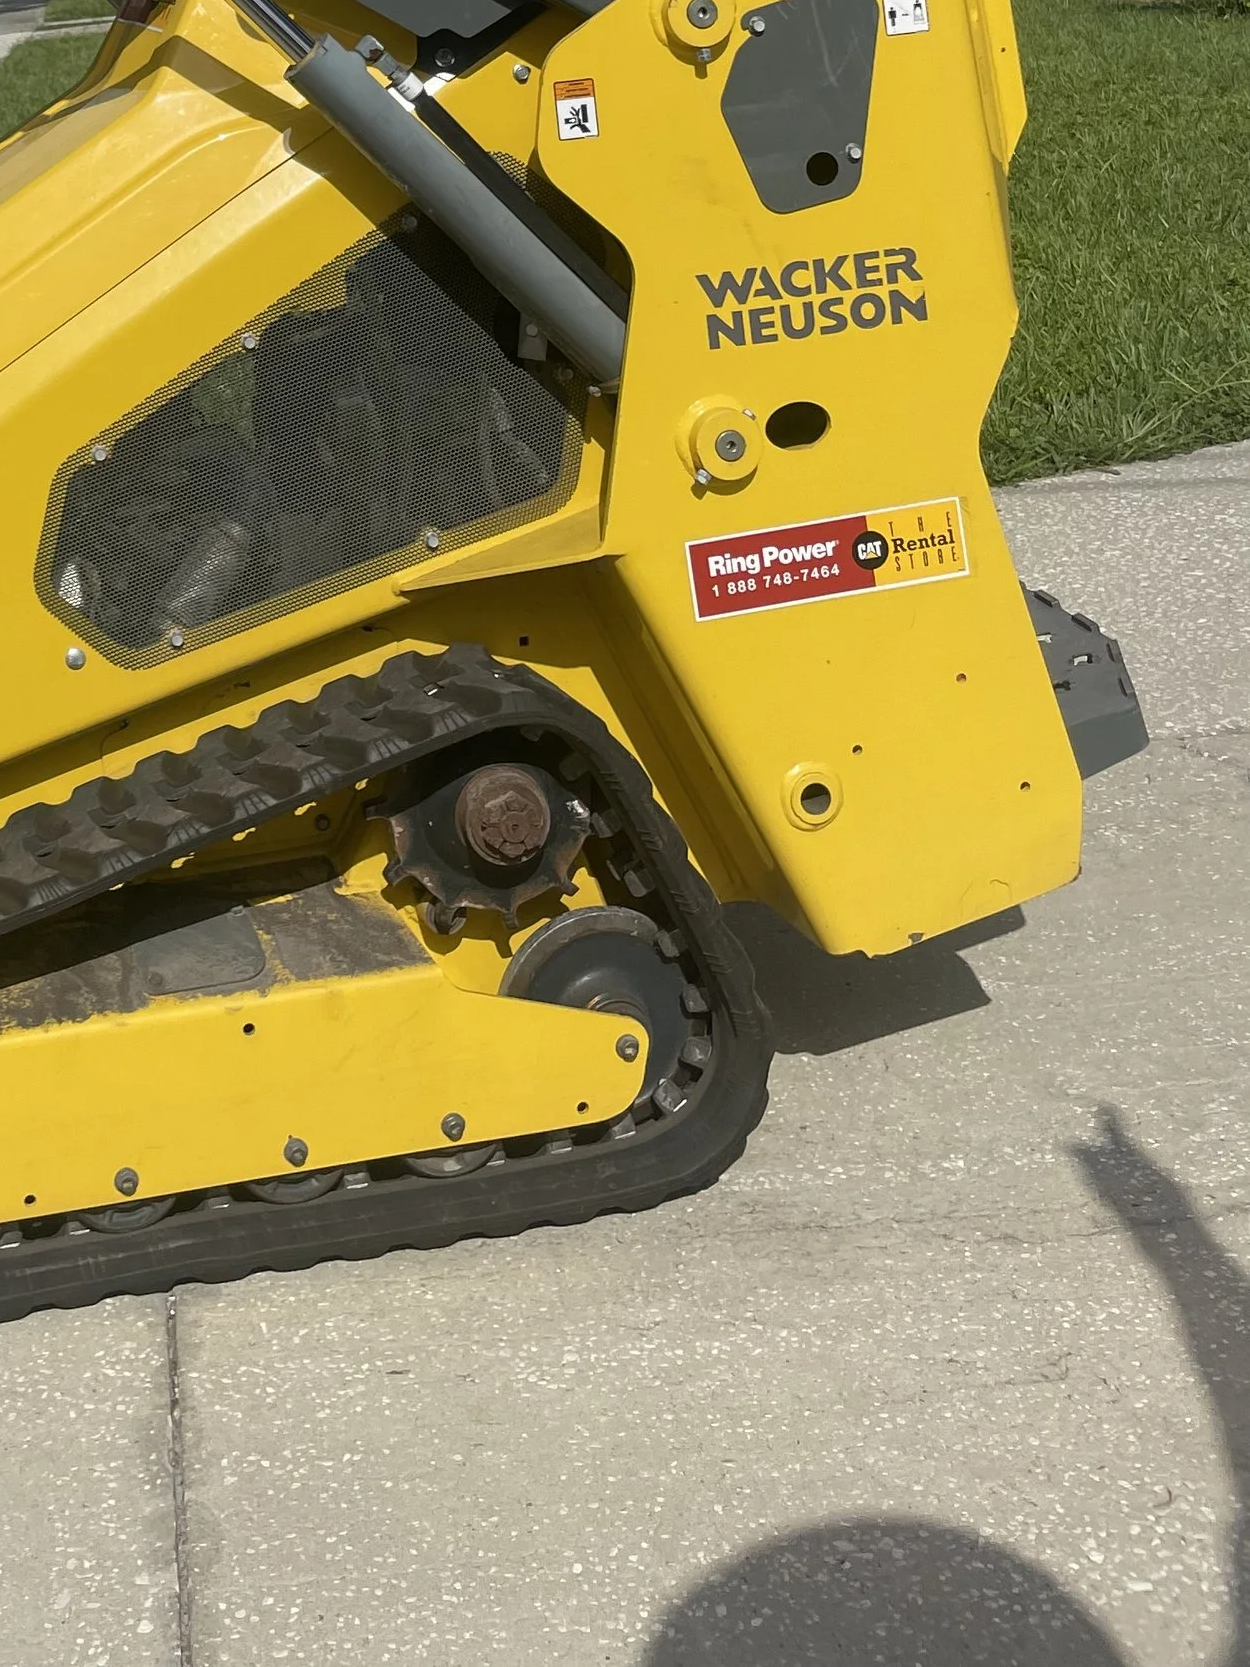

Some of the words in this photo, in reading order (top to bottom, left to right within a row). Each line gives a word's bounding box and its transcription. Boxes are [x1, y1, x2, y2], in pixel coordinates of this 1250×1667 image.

[695, 246, 924, 308] WACKER
[706, 288, 929, 350] NEUSON
[707, 552, 761, 578] Ring
[762, 539, 837, 568] Power
[857, 540, 882, 561] CAT
[891, 529, 956, 555] Rental
[895, 546, 957, 572] STORE
[711, 584, 720, 598] 1
[727, 577, 757, 595] 888
[762, 563, 840, 589] 748-7464
